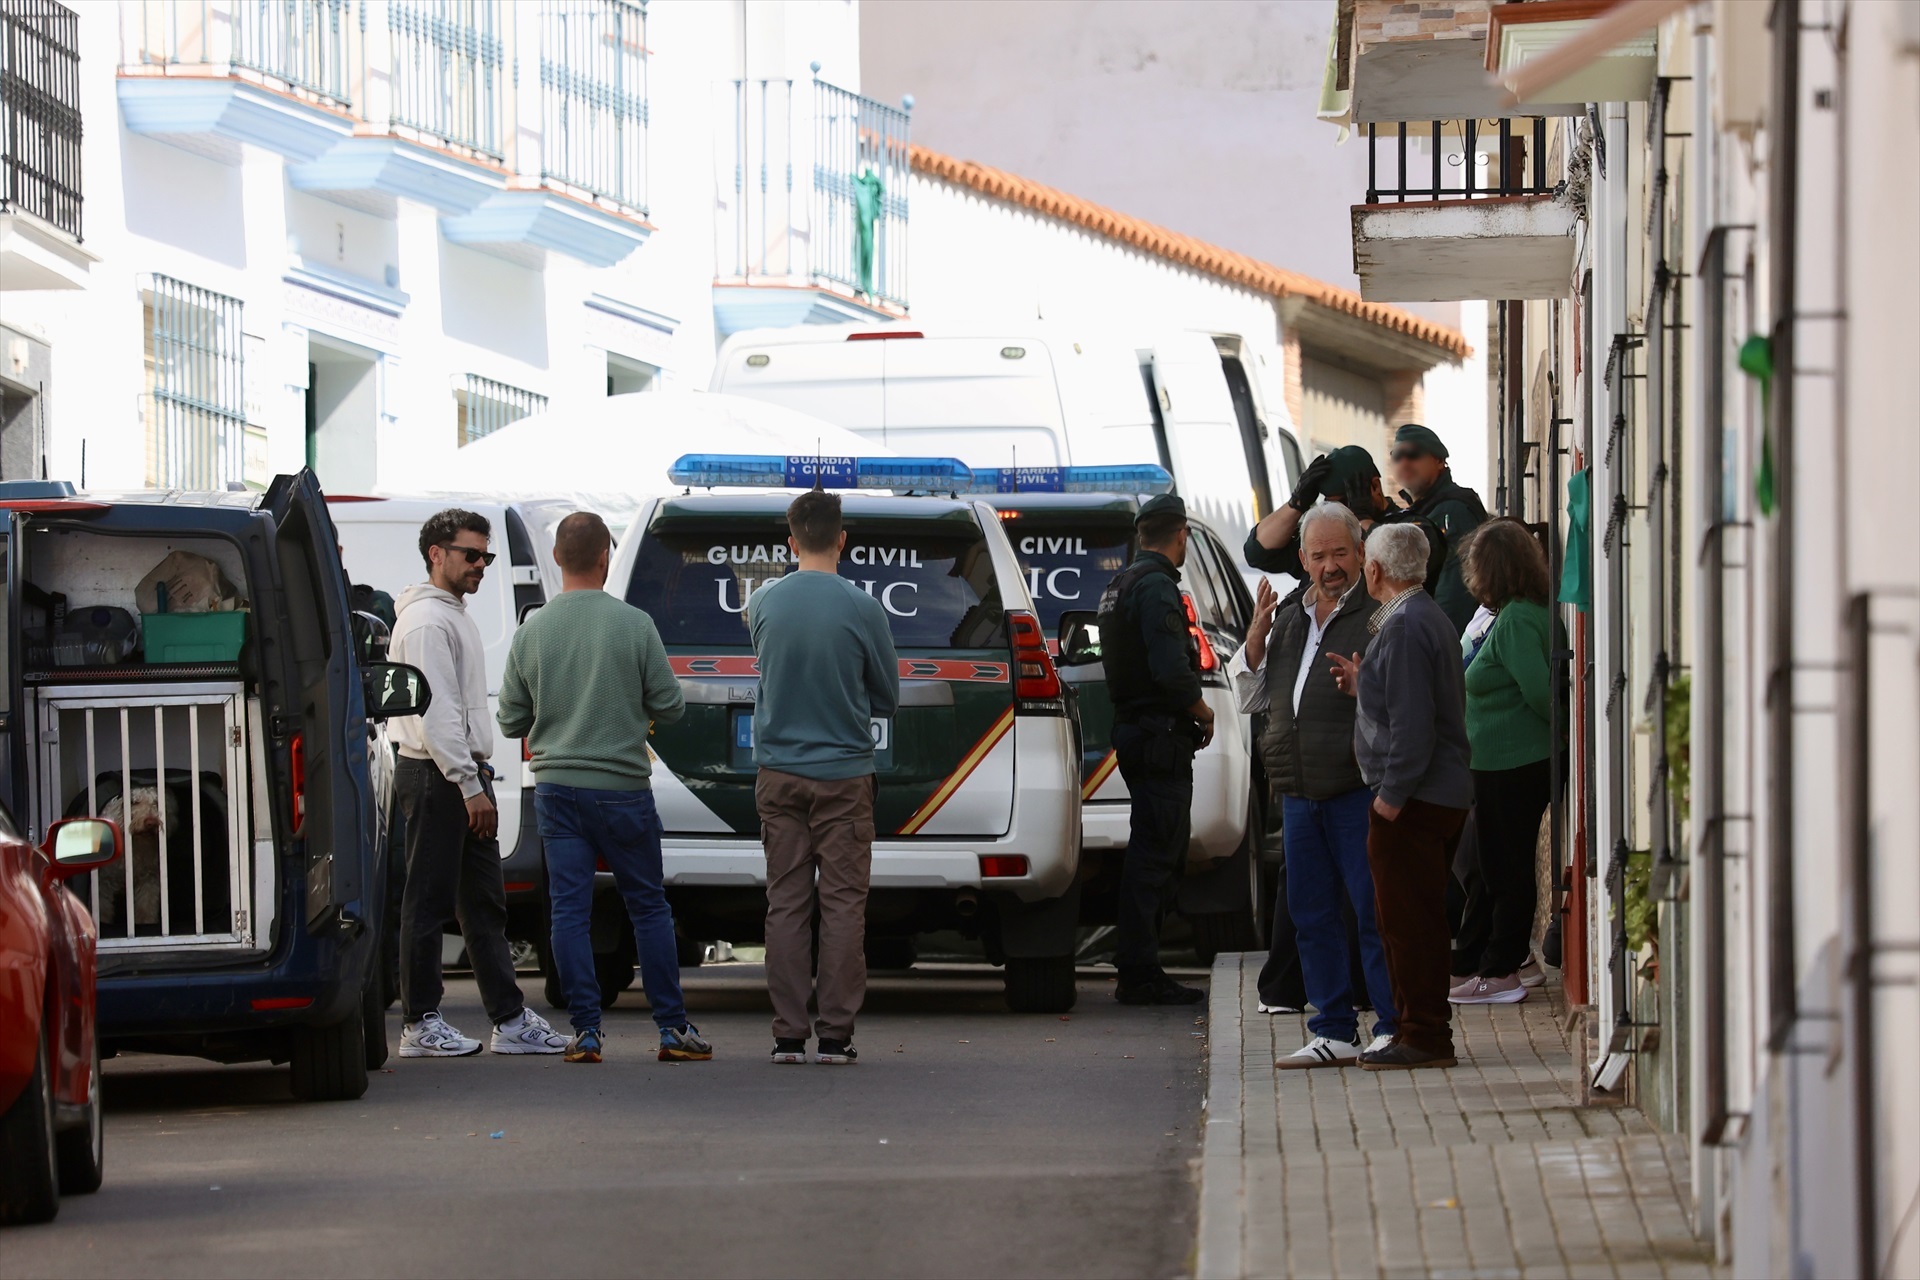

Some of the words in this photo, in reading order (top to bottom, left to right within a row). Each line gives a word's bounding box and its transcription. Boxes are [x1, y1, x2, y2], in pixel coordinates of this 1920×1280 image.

[790, 456, 851, 465] GUARDIA
[802, 465, 839, 475] CIVIL
[1002, 467, 1059, 475] GUARDIA
[1016, 474, 1048, 484] CIVIL
[1020, 536, 1088, 556] CIVIL
[850, 546, 923, 569] CIVIL
[741, 734, 747, 742] E
